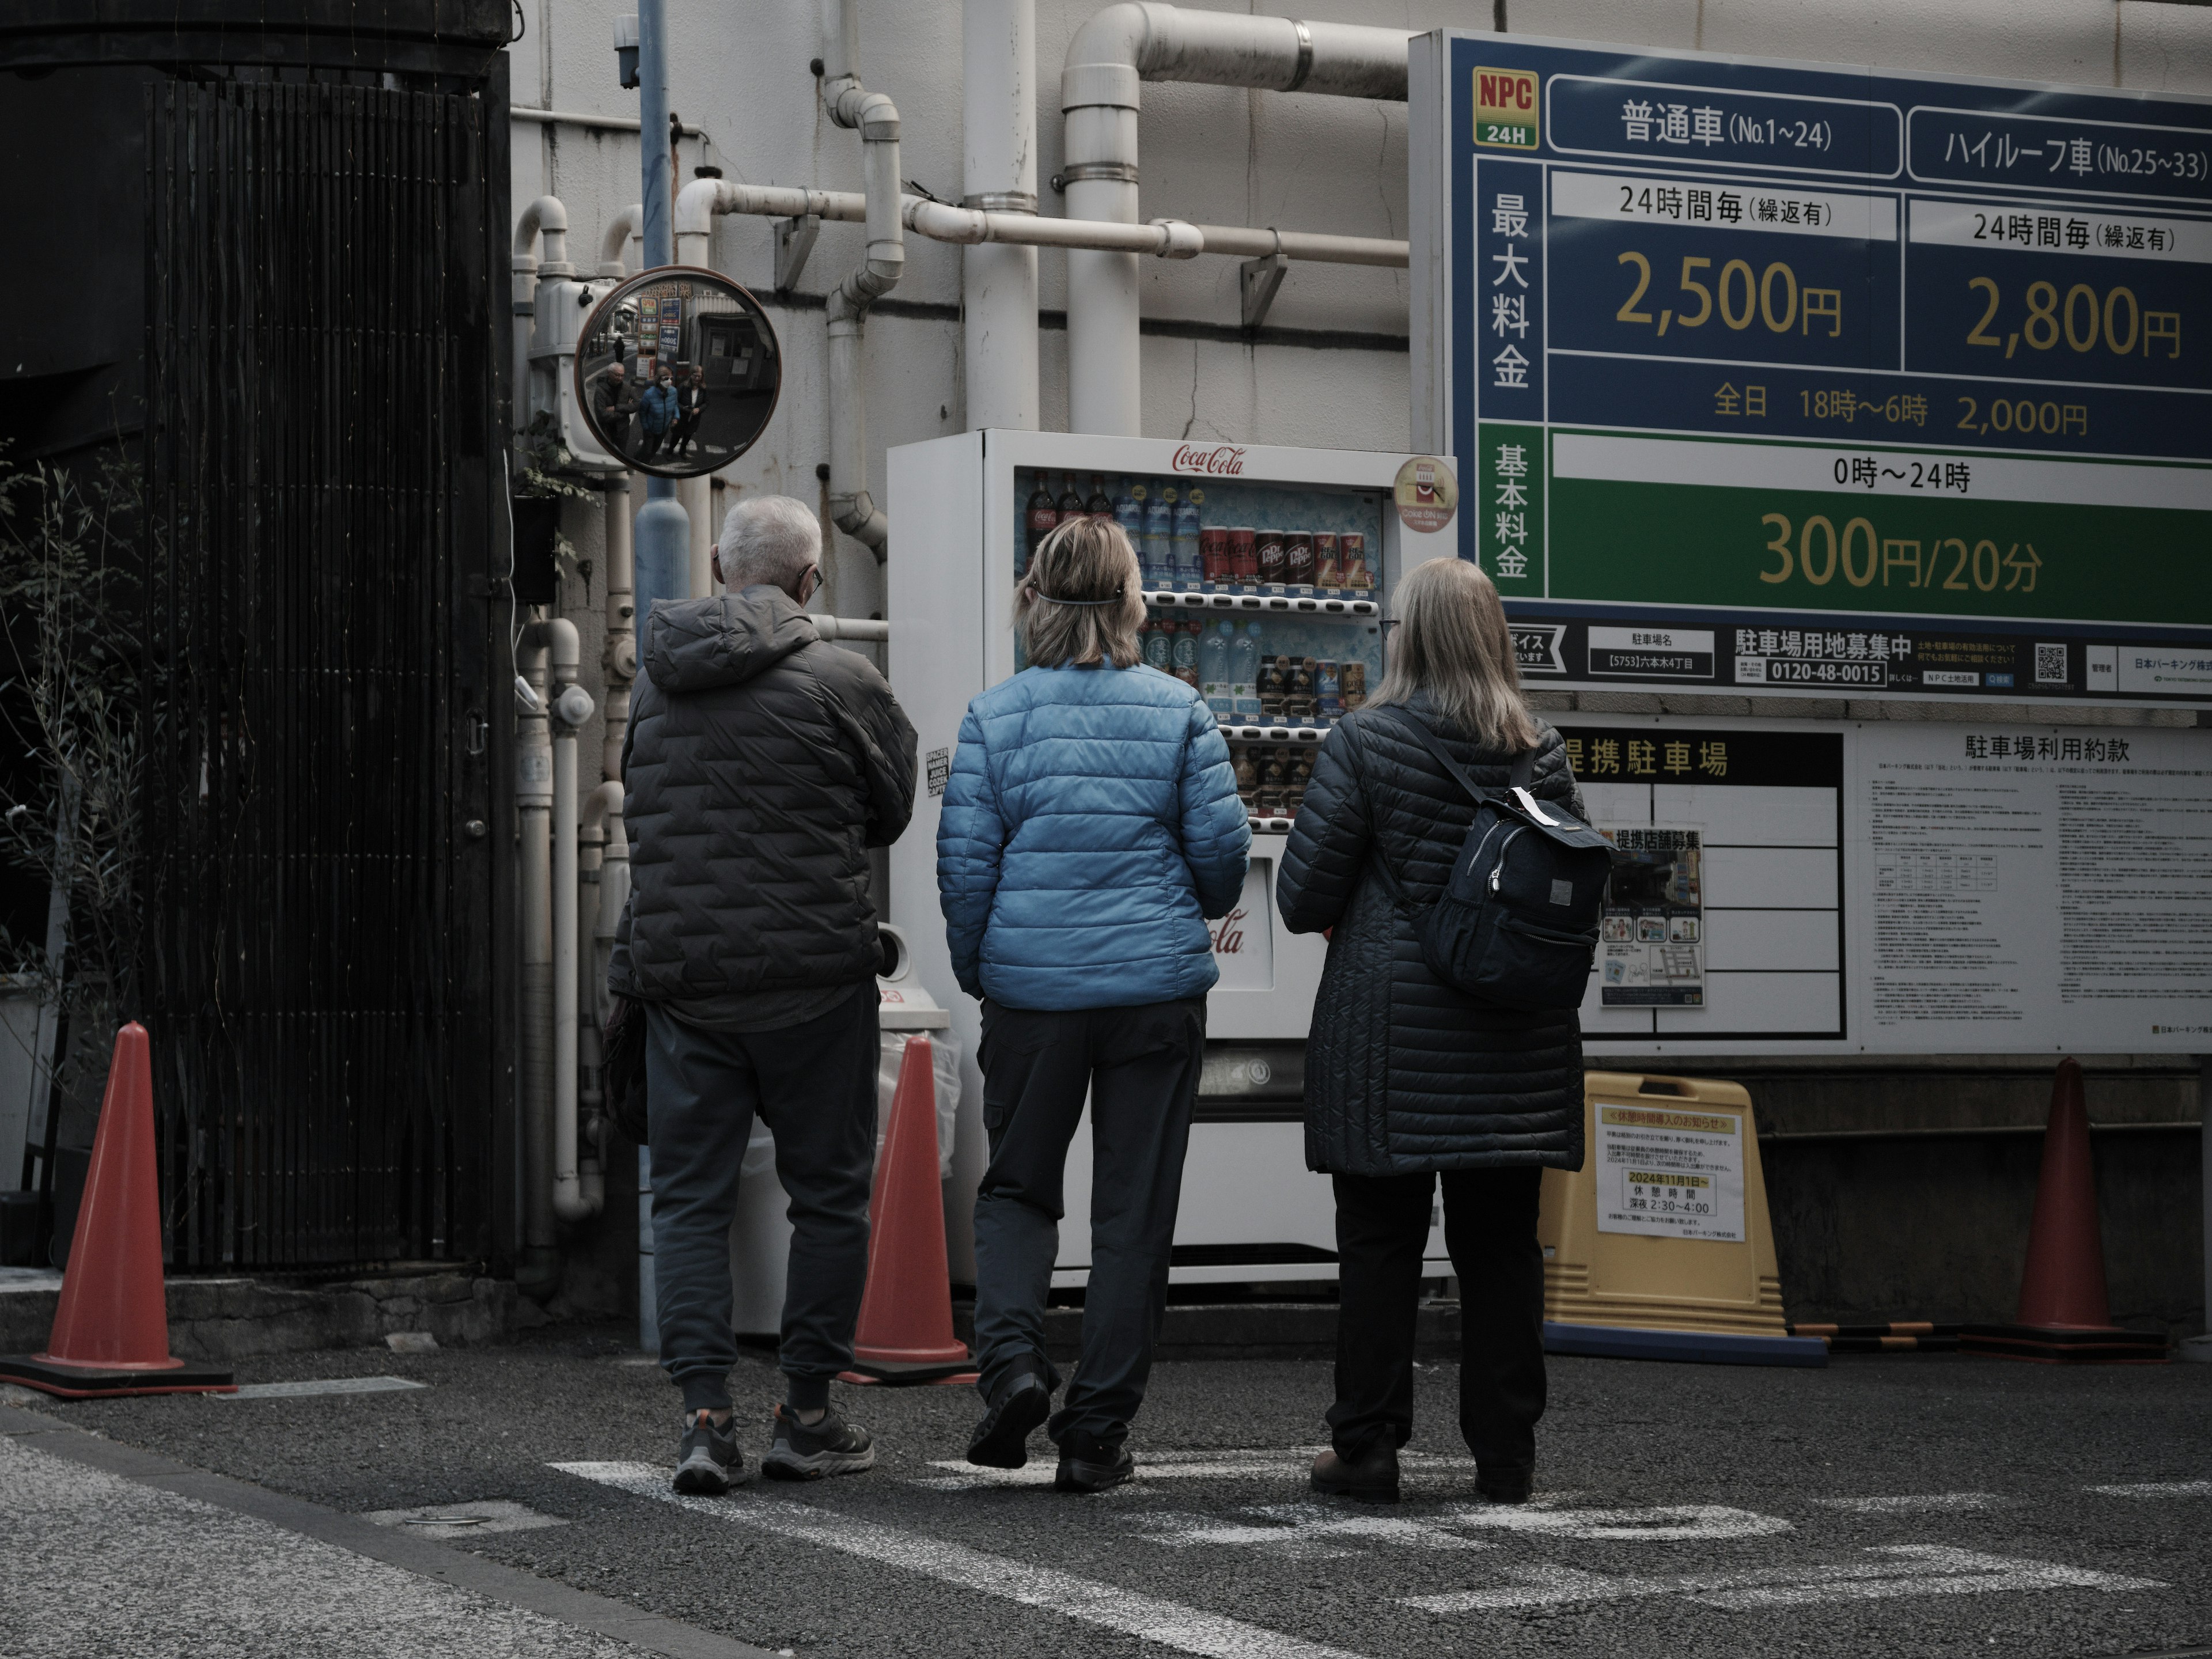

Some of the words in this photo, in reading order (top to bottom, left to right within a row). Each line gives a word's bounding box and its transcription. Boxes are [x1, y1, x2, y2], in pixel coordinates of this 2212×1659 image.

[1479, 74, 1532, 111] NPC
[1487, 125, 1525, 145] 24H
[1492, 194, 1529, 389] 最大料金
[1616, 251, 1842, 338] 2,500円
[1965, 276, 2181, 359] 2,800円
[1714, 381, 1767, 418] 全日
[1957, 396, 2088, 437] 2,000円
[1172, 444, 1247, 475] Coca-Cola
[1402, 509, 1422, 518] Coke
[1423, 509, 1435, 519] ON
[1495, 443, 1529, 578] 基本料金
[1270, 545, 1281, 554] Dr
[1297, 546, 1308, 555] Dr
[1760, 513, 2043, 593] 300円/20分
[1632, 633, 1672, 646] 駐車場名
[1735, 628, 1911, 662] 駐車場用地募集中
[1609, 654, 1693, 670] 【5753】六本木4丁目
[2092, 664, 2112, 673] 管理者
[1772, 662, 1881, 683] 0120-48-0015
[926, 748, 948, 762] SPACER
[1965, 734, 2131, 763] 駐車場利用約款
[927, 757, 948, 770] NAMER
[930, 766, 947, 779] JUICE
[1616, 830, 1700, 850] 提携店舗募集
[1630, 1198, 1647, 1210] 深夜
[1683, 1229, 1737, 1239] 日本パーキング株式会社
